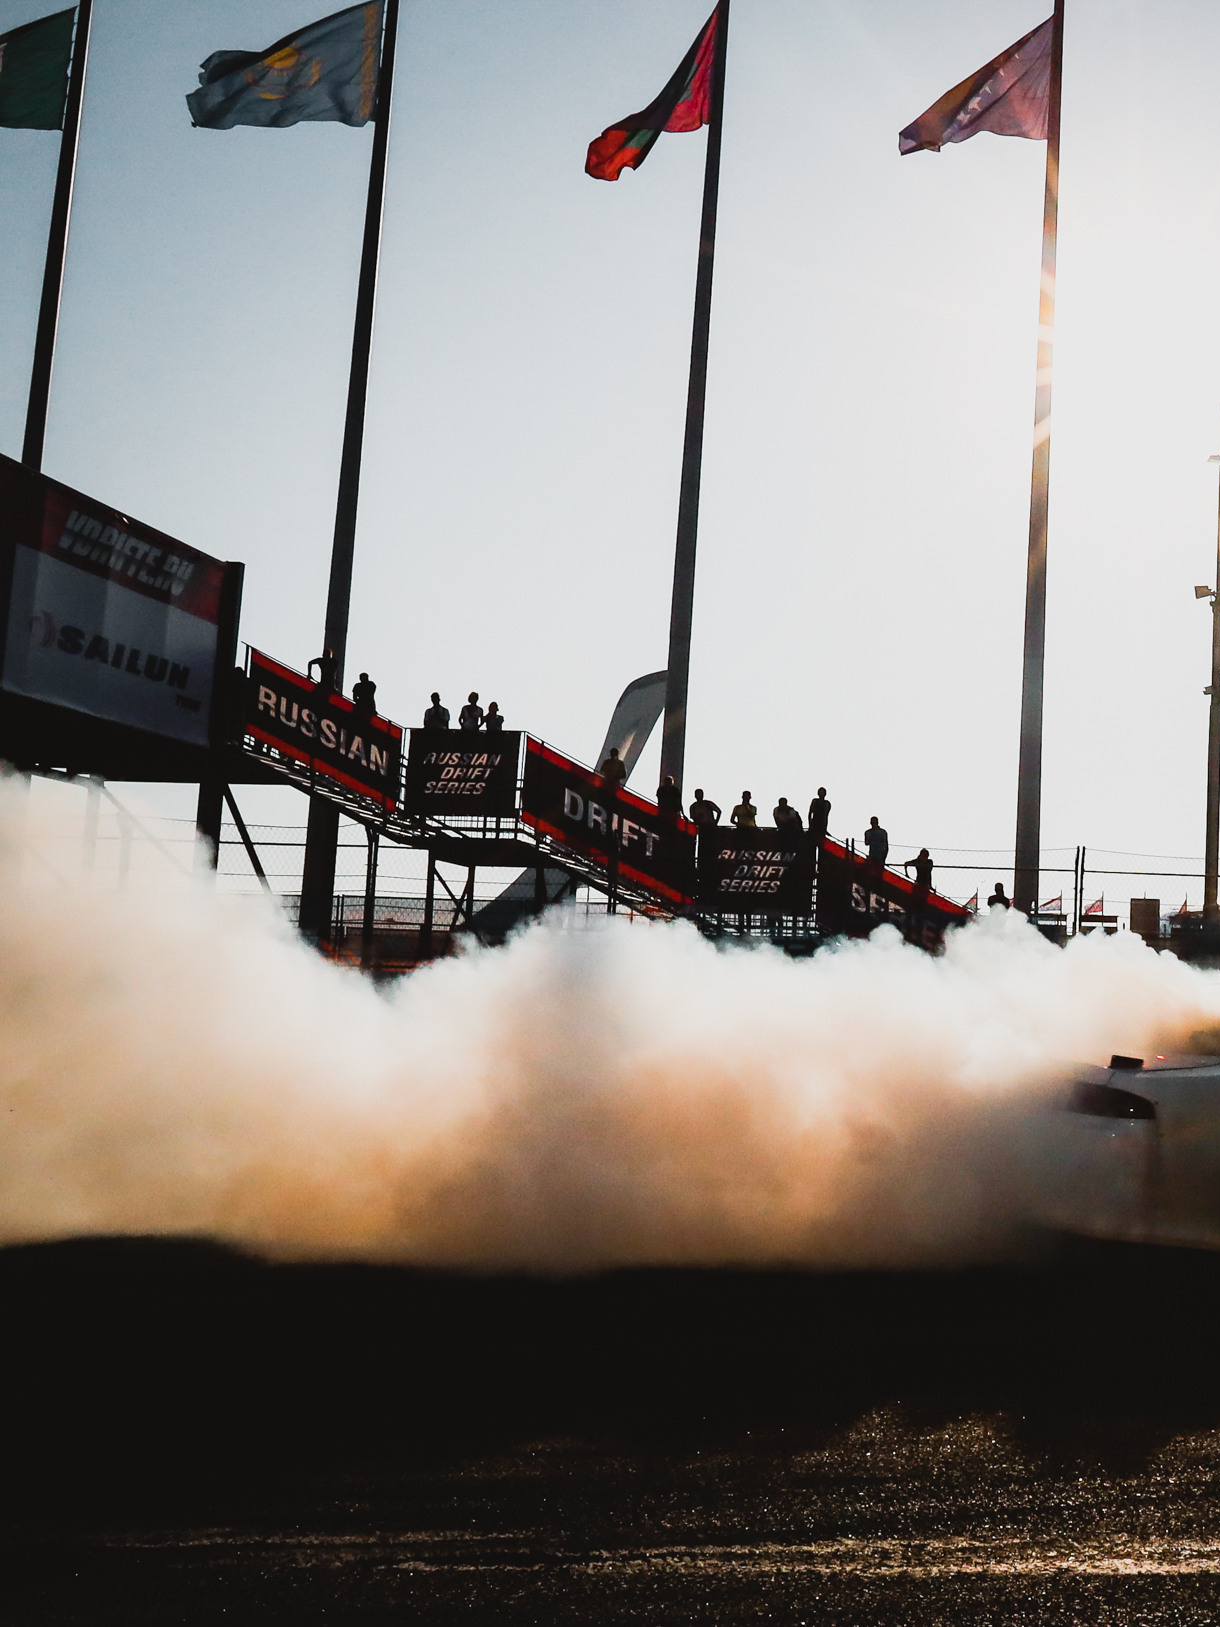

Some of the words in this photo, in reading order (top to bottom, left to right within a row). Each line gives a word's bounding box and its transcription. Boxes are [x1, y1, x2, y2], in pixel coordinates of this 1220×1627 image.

[56, 624, 191, 690] SAILUN
[257, 684, 389, 776] RUSSIAN
[423, 752, 502, 765] RUSSIAN
[440, 767, 495, 779] DRIFT
[424, 781, 486, 794] SERIES
[564, 787, 660, 856] DRIFT
[718, 849, 797, 861] RUSSIAN
[734, 865, 788, 878] DRIFT
[719, 879, 781, 892] SERIES
